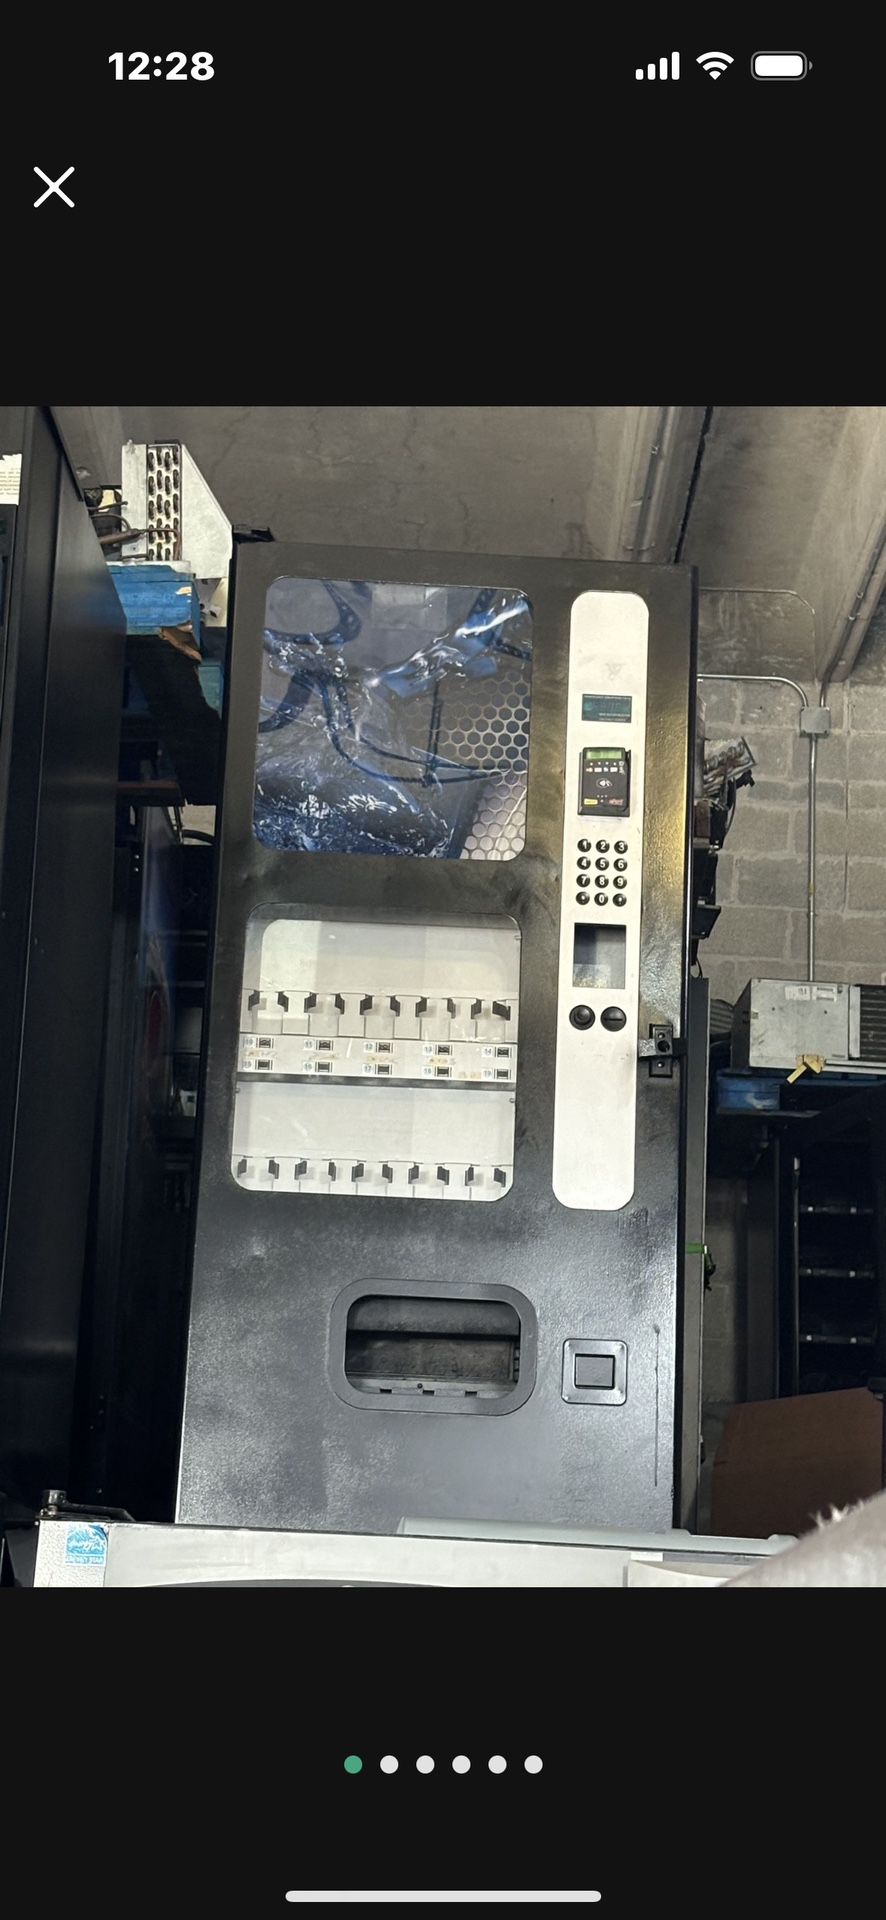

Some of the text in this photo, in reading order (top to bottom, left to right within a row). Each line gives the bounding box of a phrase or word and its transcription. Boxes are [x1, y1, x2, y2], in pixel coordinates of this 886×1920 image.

[582, 840, 625, 852] 1 2 3
[581, 858, 625, 869] 4 5 6
[581, 876, 624, 887] 7 8 9
[598, 894, 605, 904] 0
[305, 1040, 313, 1049] 11
[484, 1047, 492, 1056] 14
[363, 1064, 372, 1072] 17
